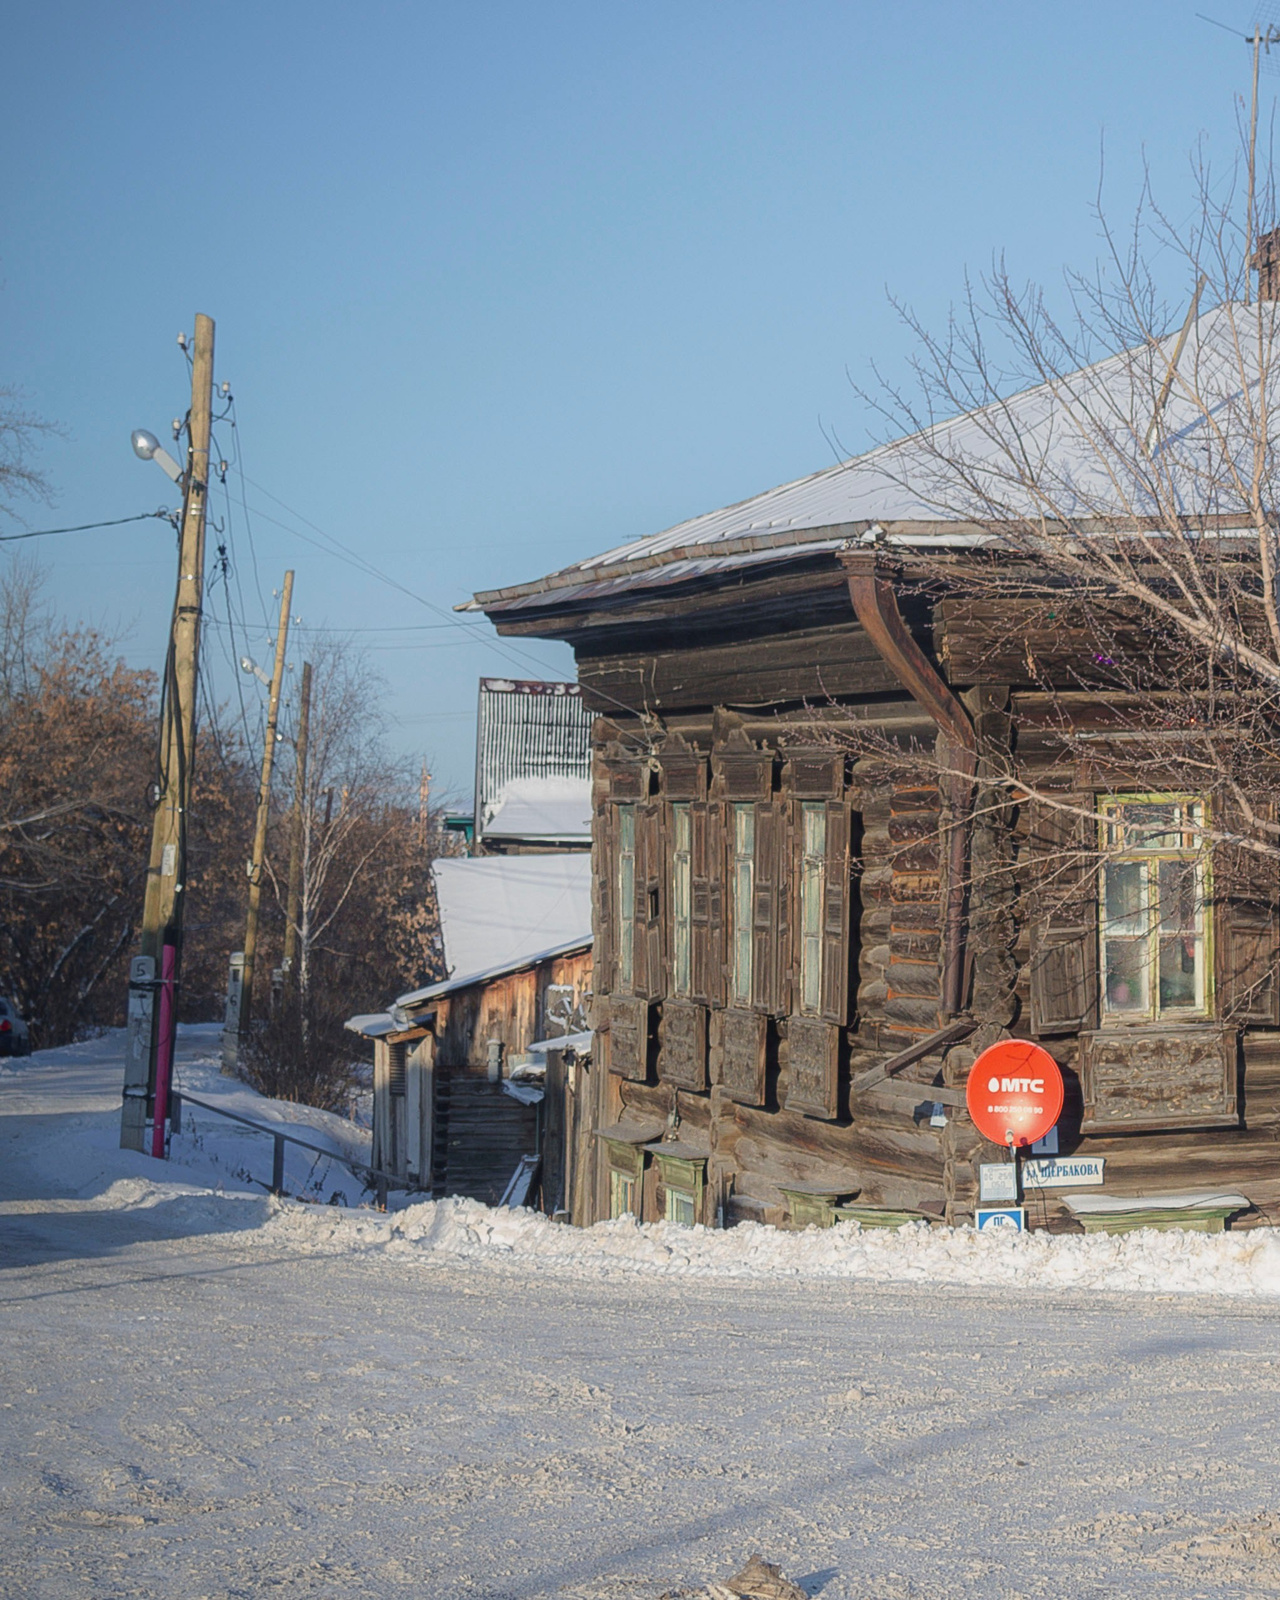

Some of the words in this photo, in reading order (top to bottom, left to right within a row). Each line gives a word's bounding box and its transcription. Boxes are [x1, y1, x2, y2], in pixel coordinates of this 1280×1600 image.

[136, 962, 146, 977] 5
[230, 994, 238, 1006] 6
[1001, 1077, 1044, 1094] МТС
